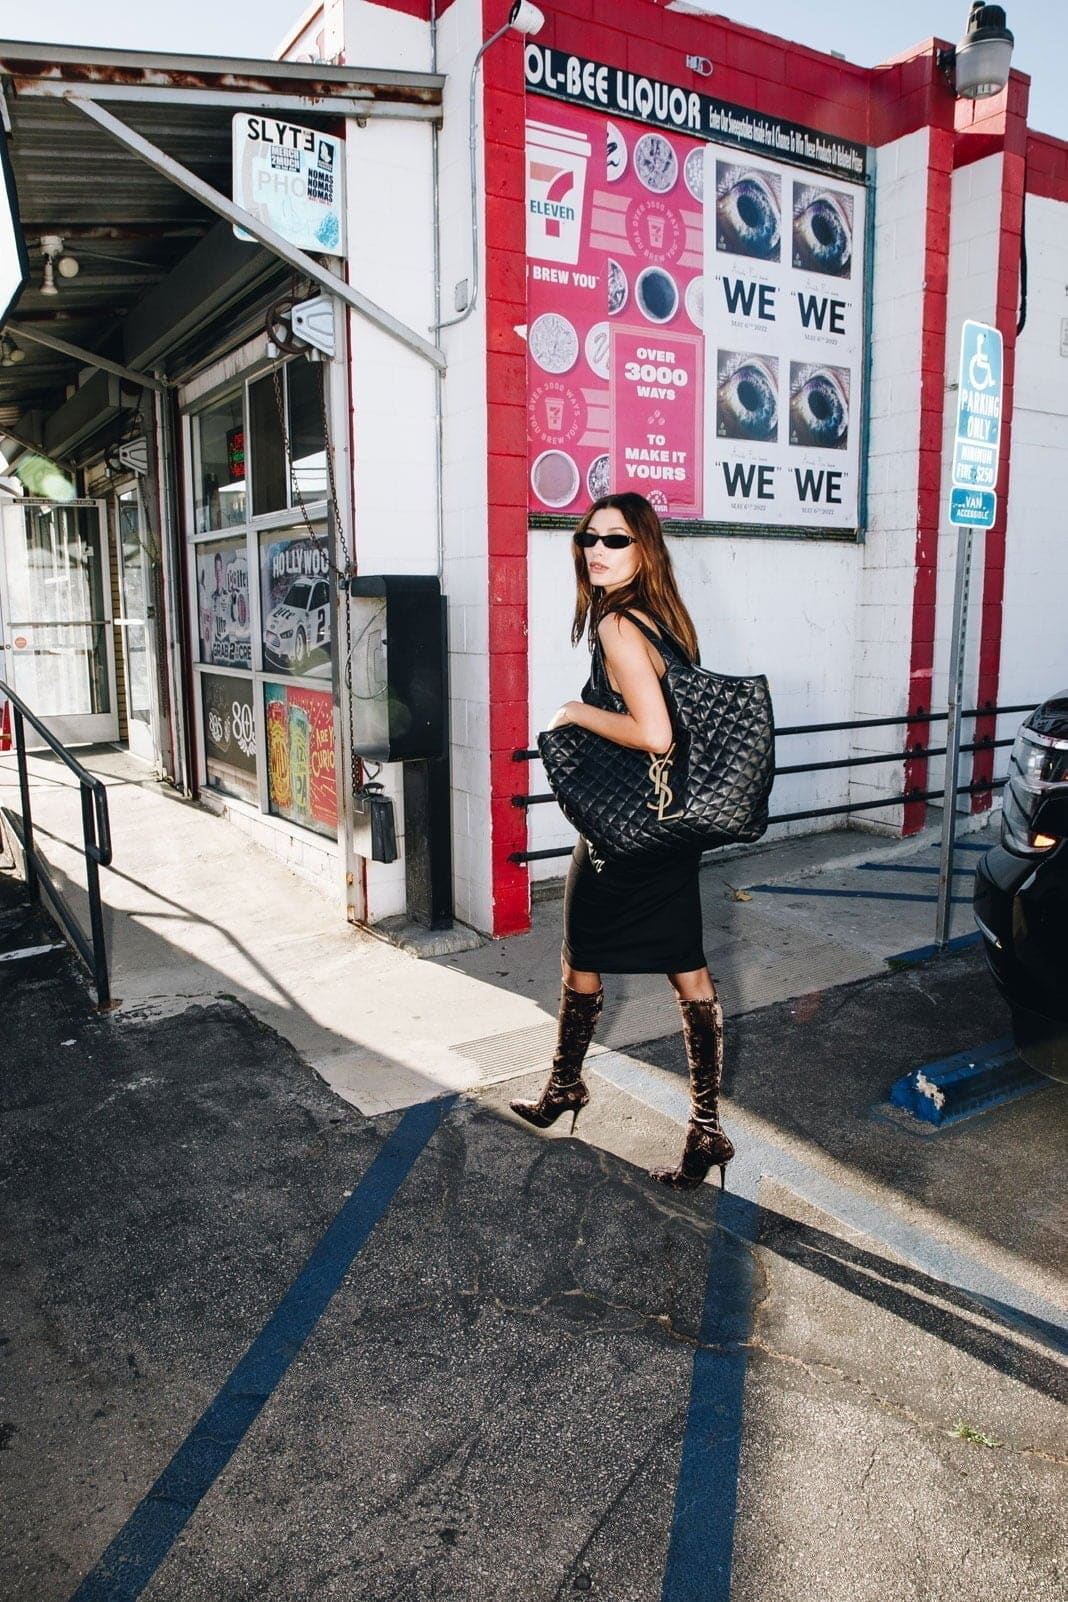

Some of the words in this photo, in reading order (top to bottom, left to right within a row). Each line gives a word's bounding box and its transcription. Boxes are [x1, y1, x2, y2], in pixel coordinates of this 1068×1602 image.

[616, 70, 701, 130] LIQUOR
[308, 168, 334, 184] NOMAS
[308, 178, 334, 194] NOMAS
[307, 187, 333, 203] NOMAS
[533, 266, 569, 284] BREW
[636, 348, 676, 364] OVER
[624, 362, 688, 386] 3000
[636, 386, 676, 400] WAYS
[960, 388, 1000, 418] PARKING
[966, 415, 992, 442] ONLY
[647, 434, 666, 446] TO
[625, 448, 670, 463] MAKE
[672, 450, 687, 464] IT
[625, 464, 686, 481] YOURS
[965, 496, 982, 509] VAN
[316, 608, 326, 644] 2
[213, 642, 228, 658] GRAB
[229, 642, 236, 660] 2
[239, 644, 252, 660] CRE
[316, 728, 328, 749] ARE
